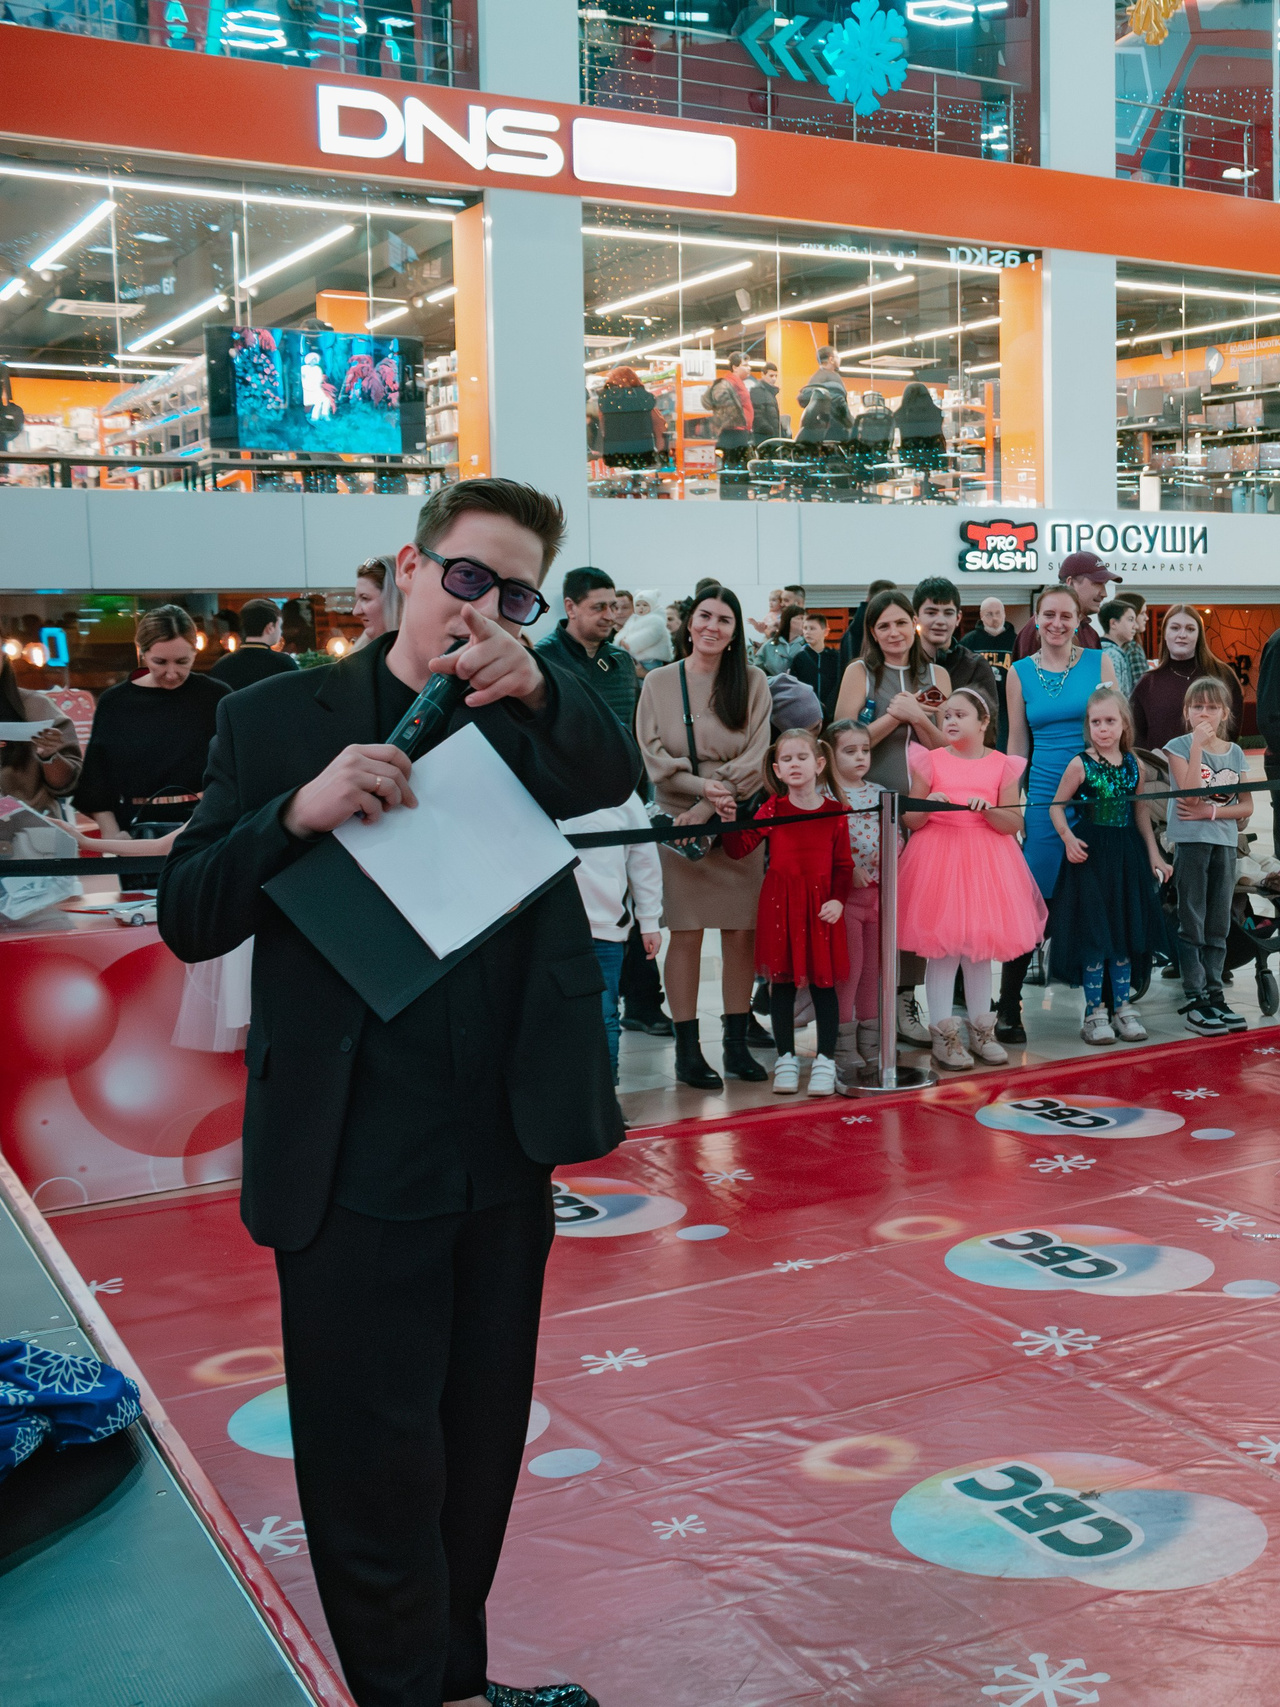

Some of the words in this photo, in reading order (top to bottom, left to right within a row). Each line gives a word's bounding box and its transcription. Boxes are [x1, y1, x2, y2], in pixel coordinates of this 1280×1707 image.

[317, 85, 564, 177] DNS
[986, 535, 1017, 551] PRO
[1050, 524, 1208, 554] ПРОСУШИ
[965, 551, 1037, 571] SUSHI
[1160, 563, 1203, 572] PASTA
[980, 652, 1011, 671] CLA
[1009, 1099, 1110, 1129] СБС
[988, 1231, 1118, 1279] СБС
[953, 1465, 1133, 1557] СБС
